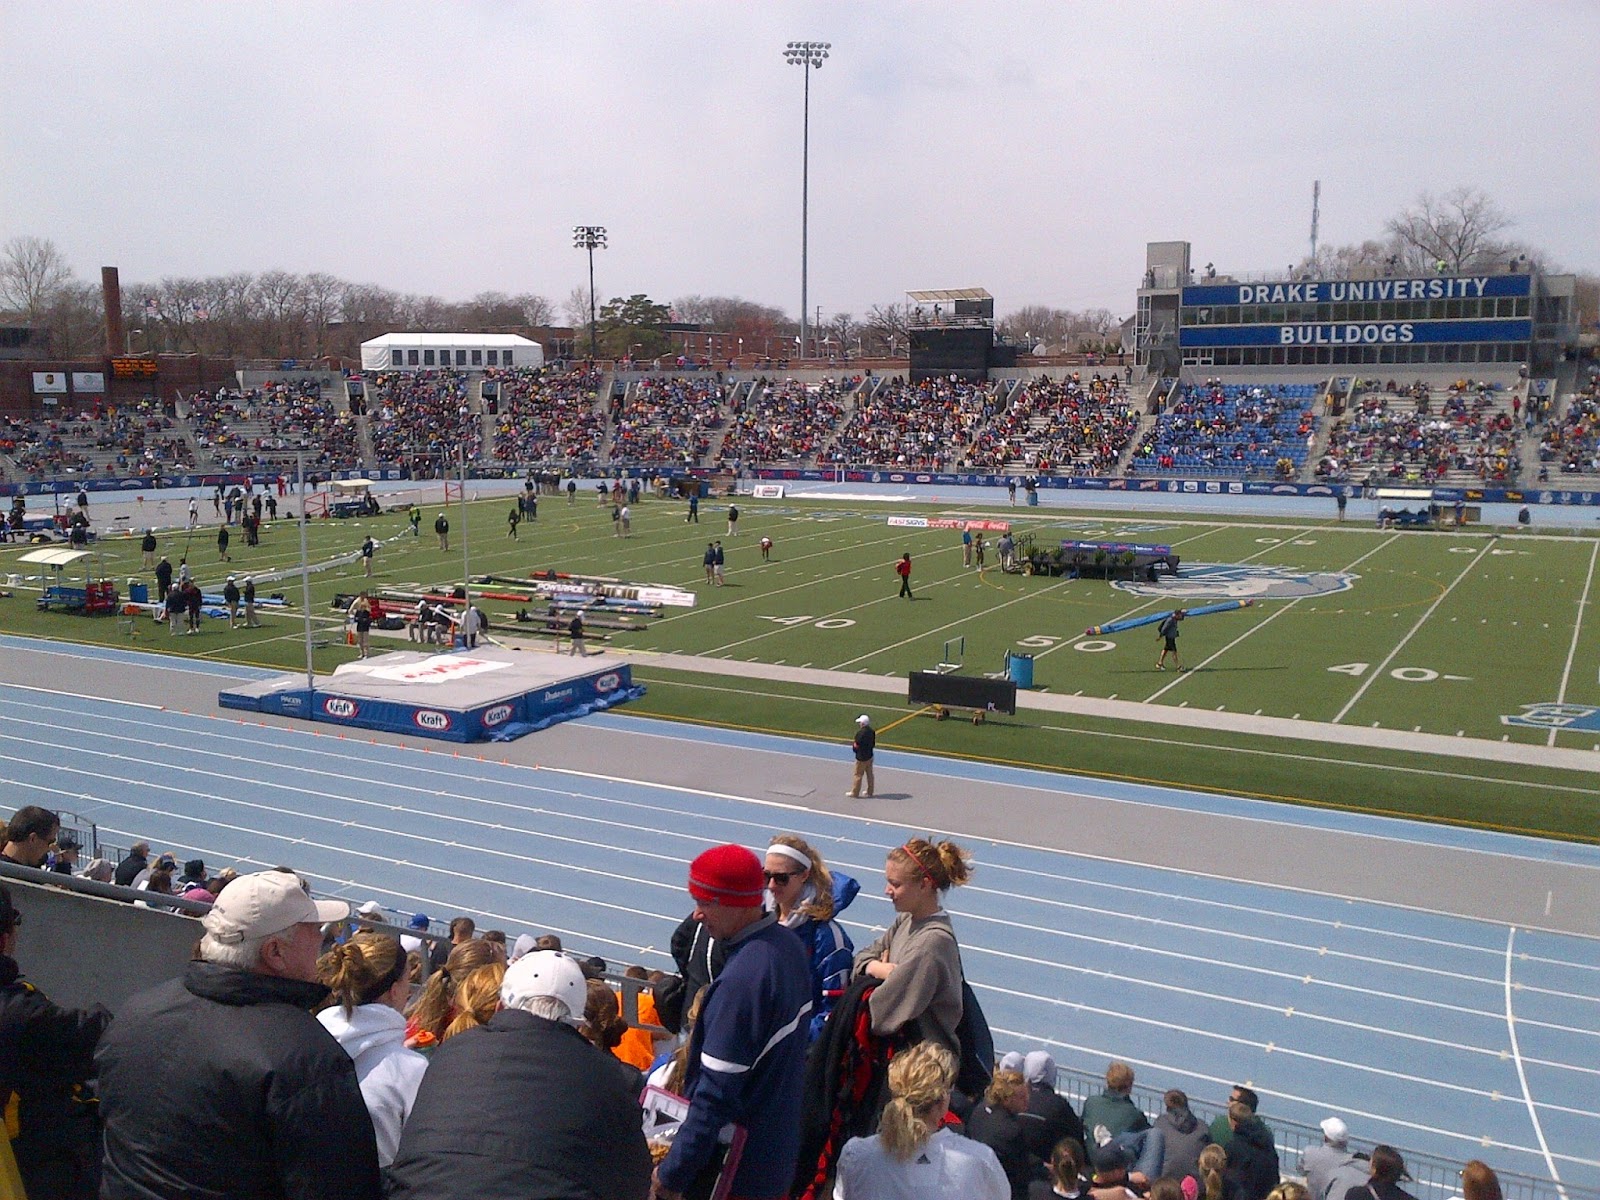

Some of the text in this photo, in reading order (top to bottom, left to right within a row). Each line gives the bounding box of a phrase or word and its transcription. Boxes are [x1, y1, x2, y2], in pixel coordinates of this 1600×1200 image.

[1238, 277, 1489, 304] DRAKE UNIVERSITY
[1280, 323, 1414, 344] BULLDOGS
[329, 700, 352, 713] Kraft
[420, 713, 444, 727] Kraft
[487, 708, 509, 722] Kraft
